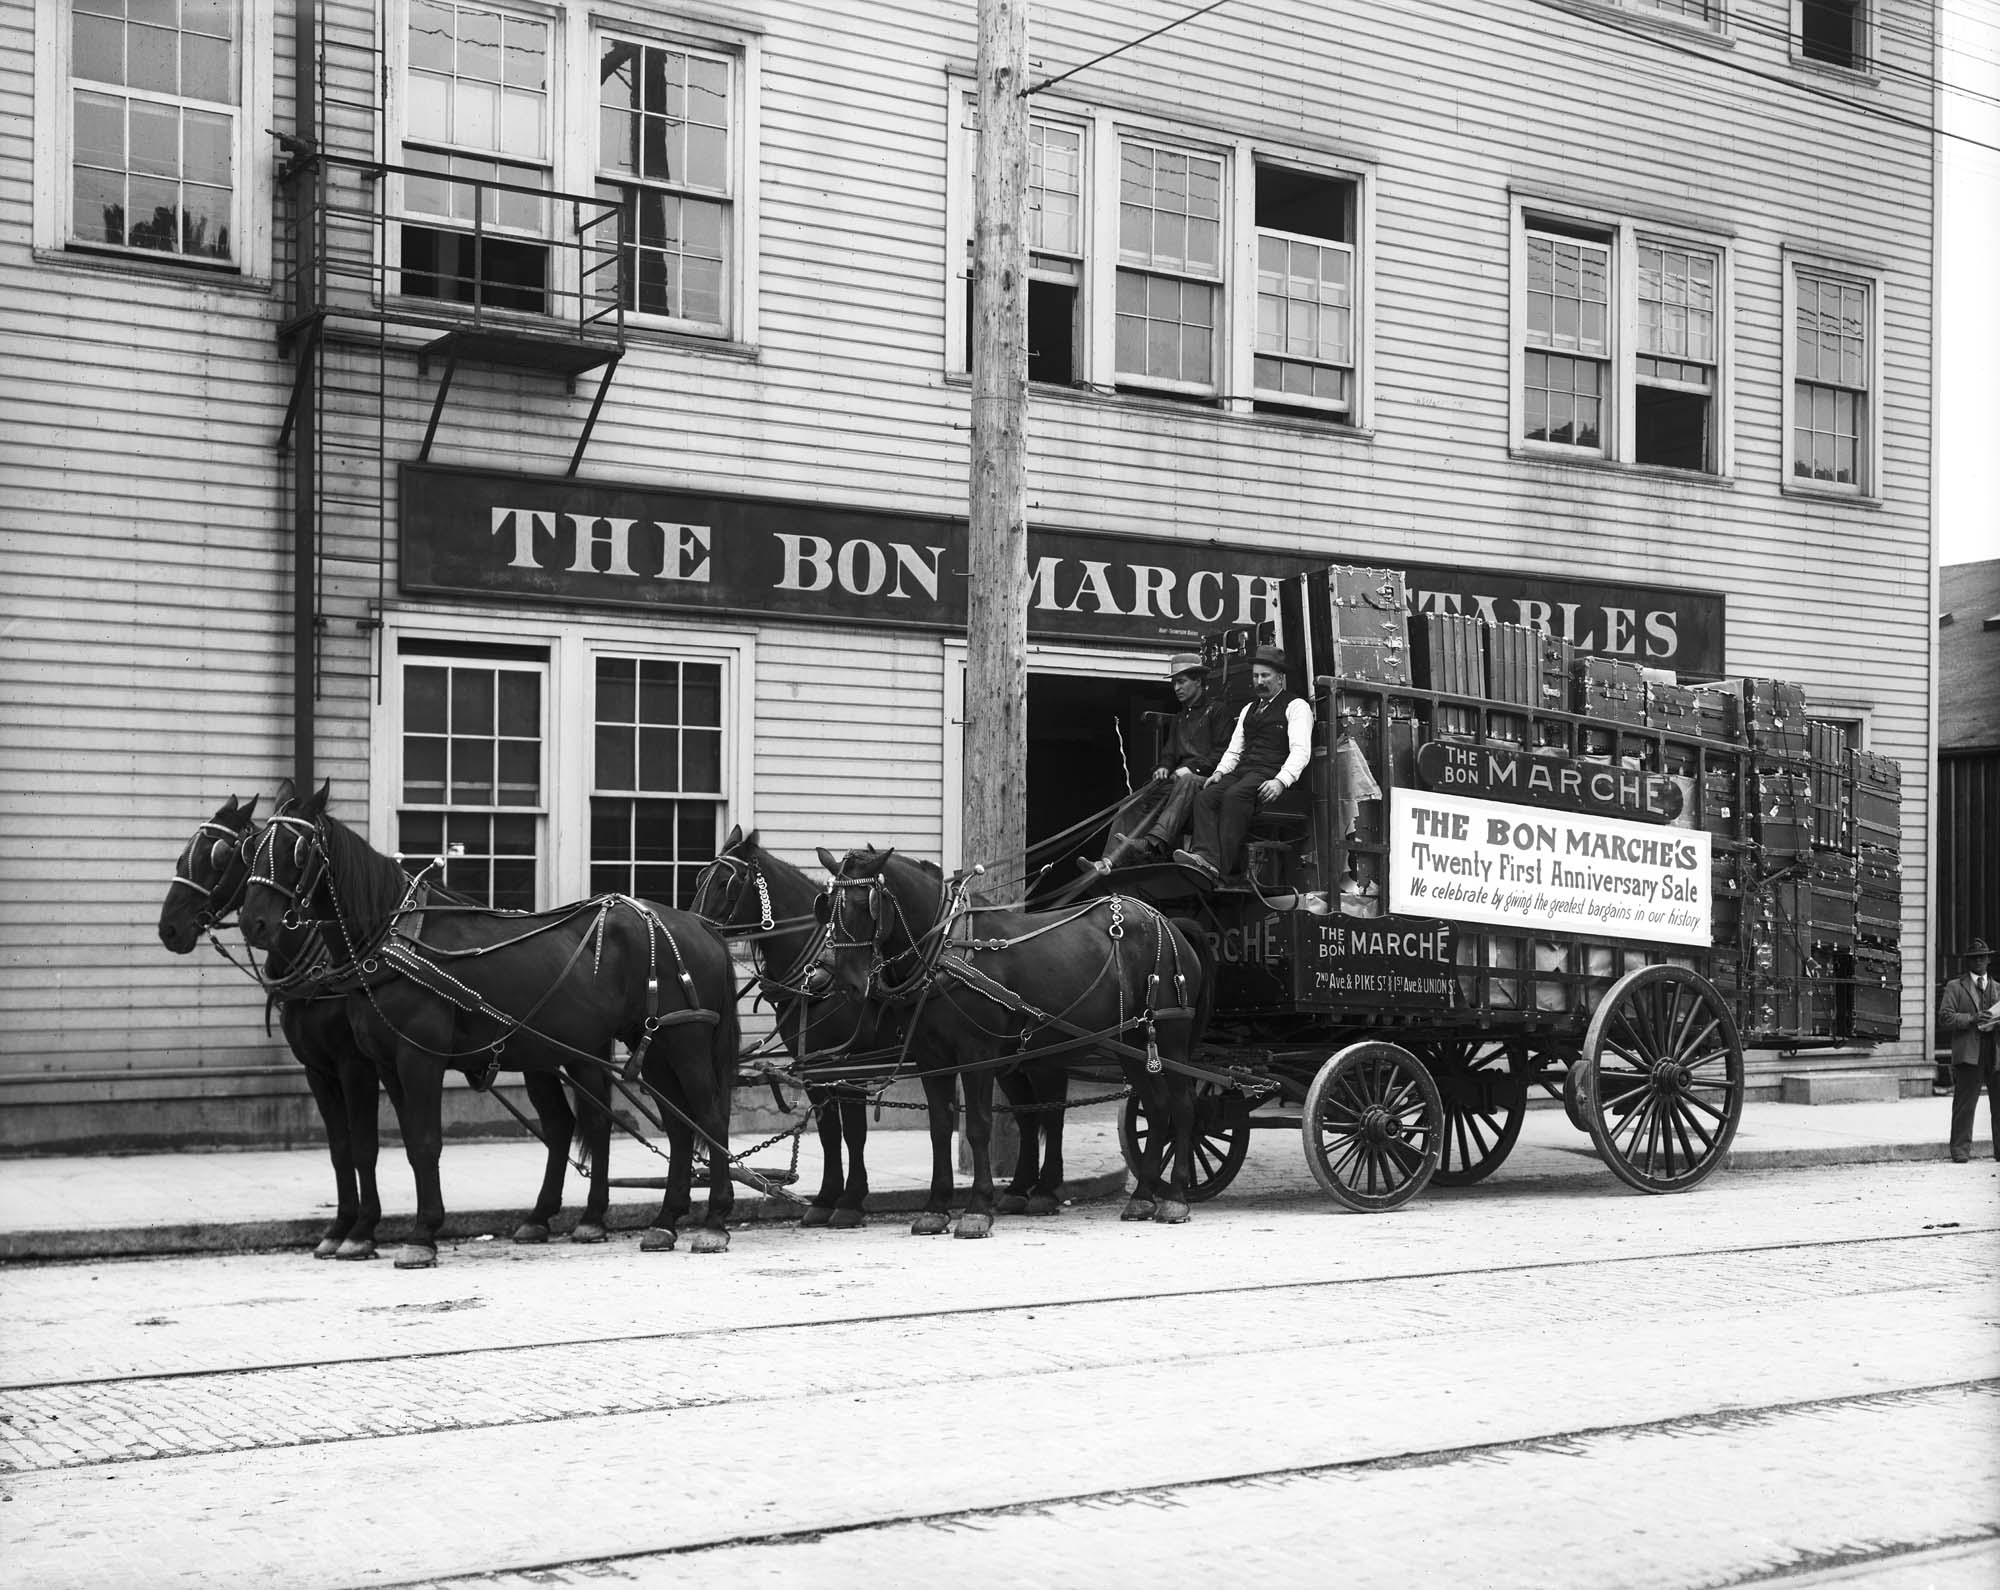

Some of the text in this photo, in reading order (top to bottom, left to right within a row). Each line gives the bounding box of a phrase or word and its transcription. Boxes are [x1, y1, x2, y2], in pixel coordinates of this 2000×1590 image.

[491, 507, 711, 583] THE
[773, 532, 946, 602] BON
[1027, 556, 1286, 626] MARCH
[1444, 766, 1479, 785] BON
[1445, 745, 1478, 767] THE
[1411, 807, 1698, 871] THE BON MARCHE'S
[1411, 842, 1698, 904] Twenty First Anniversary Sale
[1410, 876, 1428, 897] We
[1431, 881, 1489, 904] celebrate
[1491, 887, 1504, 911] by
[1503, 889, 1533, 915] giving
[1533, 892, 1549, 911] the
[1547, 896, 1586, 919] greatest
[1587, 898, 1633, 923] bargains
[1634, 904, 1645, 921] in
[1648, 910, 1666, 923] our
[1205, 911, 1280, 965] RCHÉ
[1319, 925, 1345, 941] THE
[1319, 926, 1450, 963] BON MARCHÉ
[1354, 974, 1375, 991] PIKE
[1423, 978, 1447, 994] UNION
